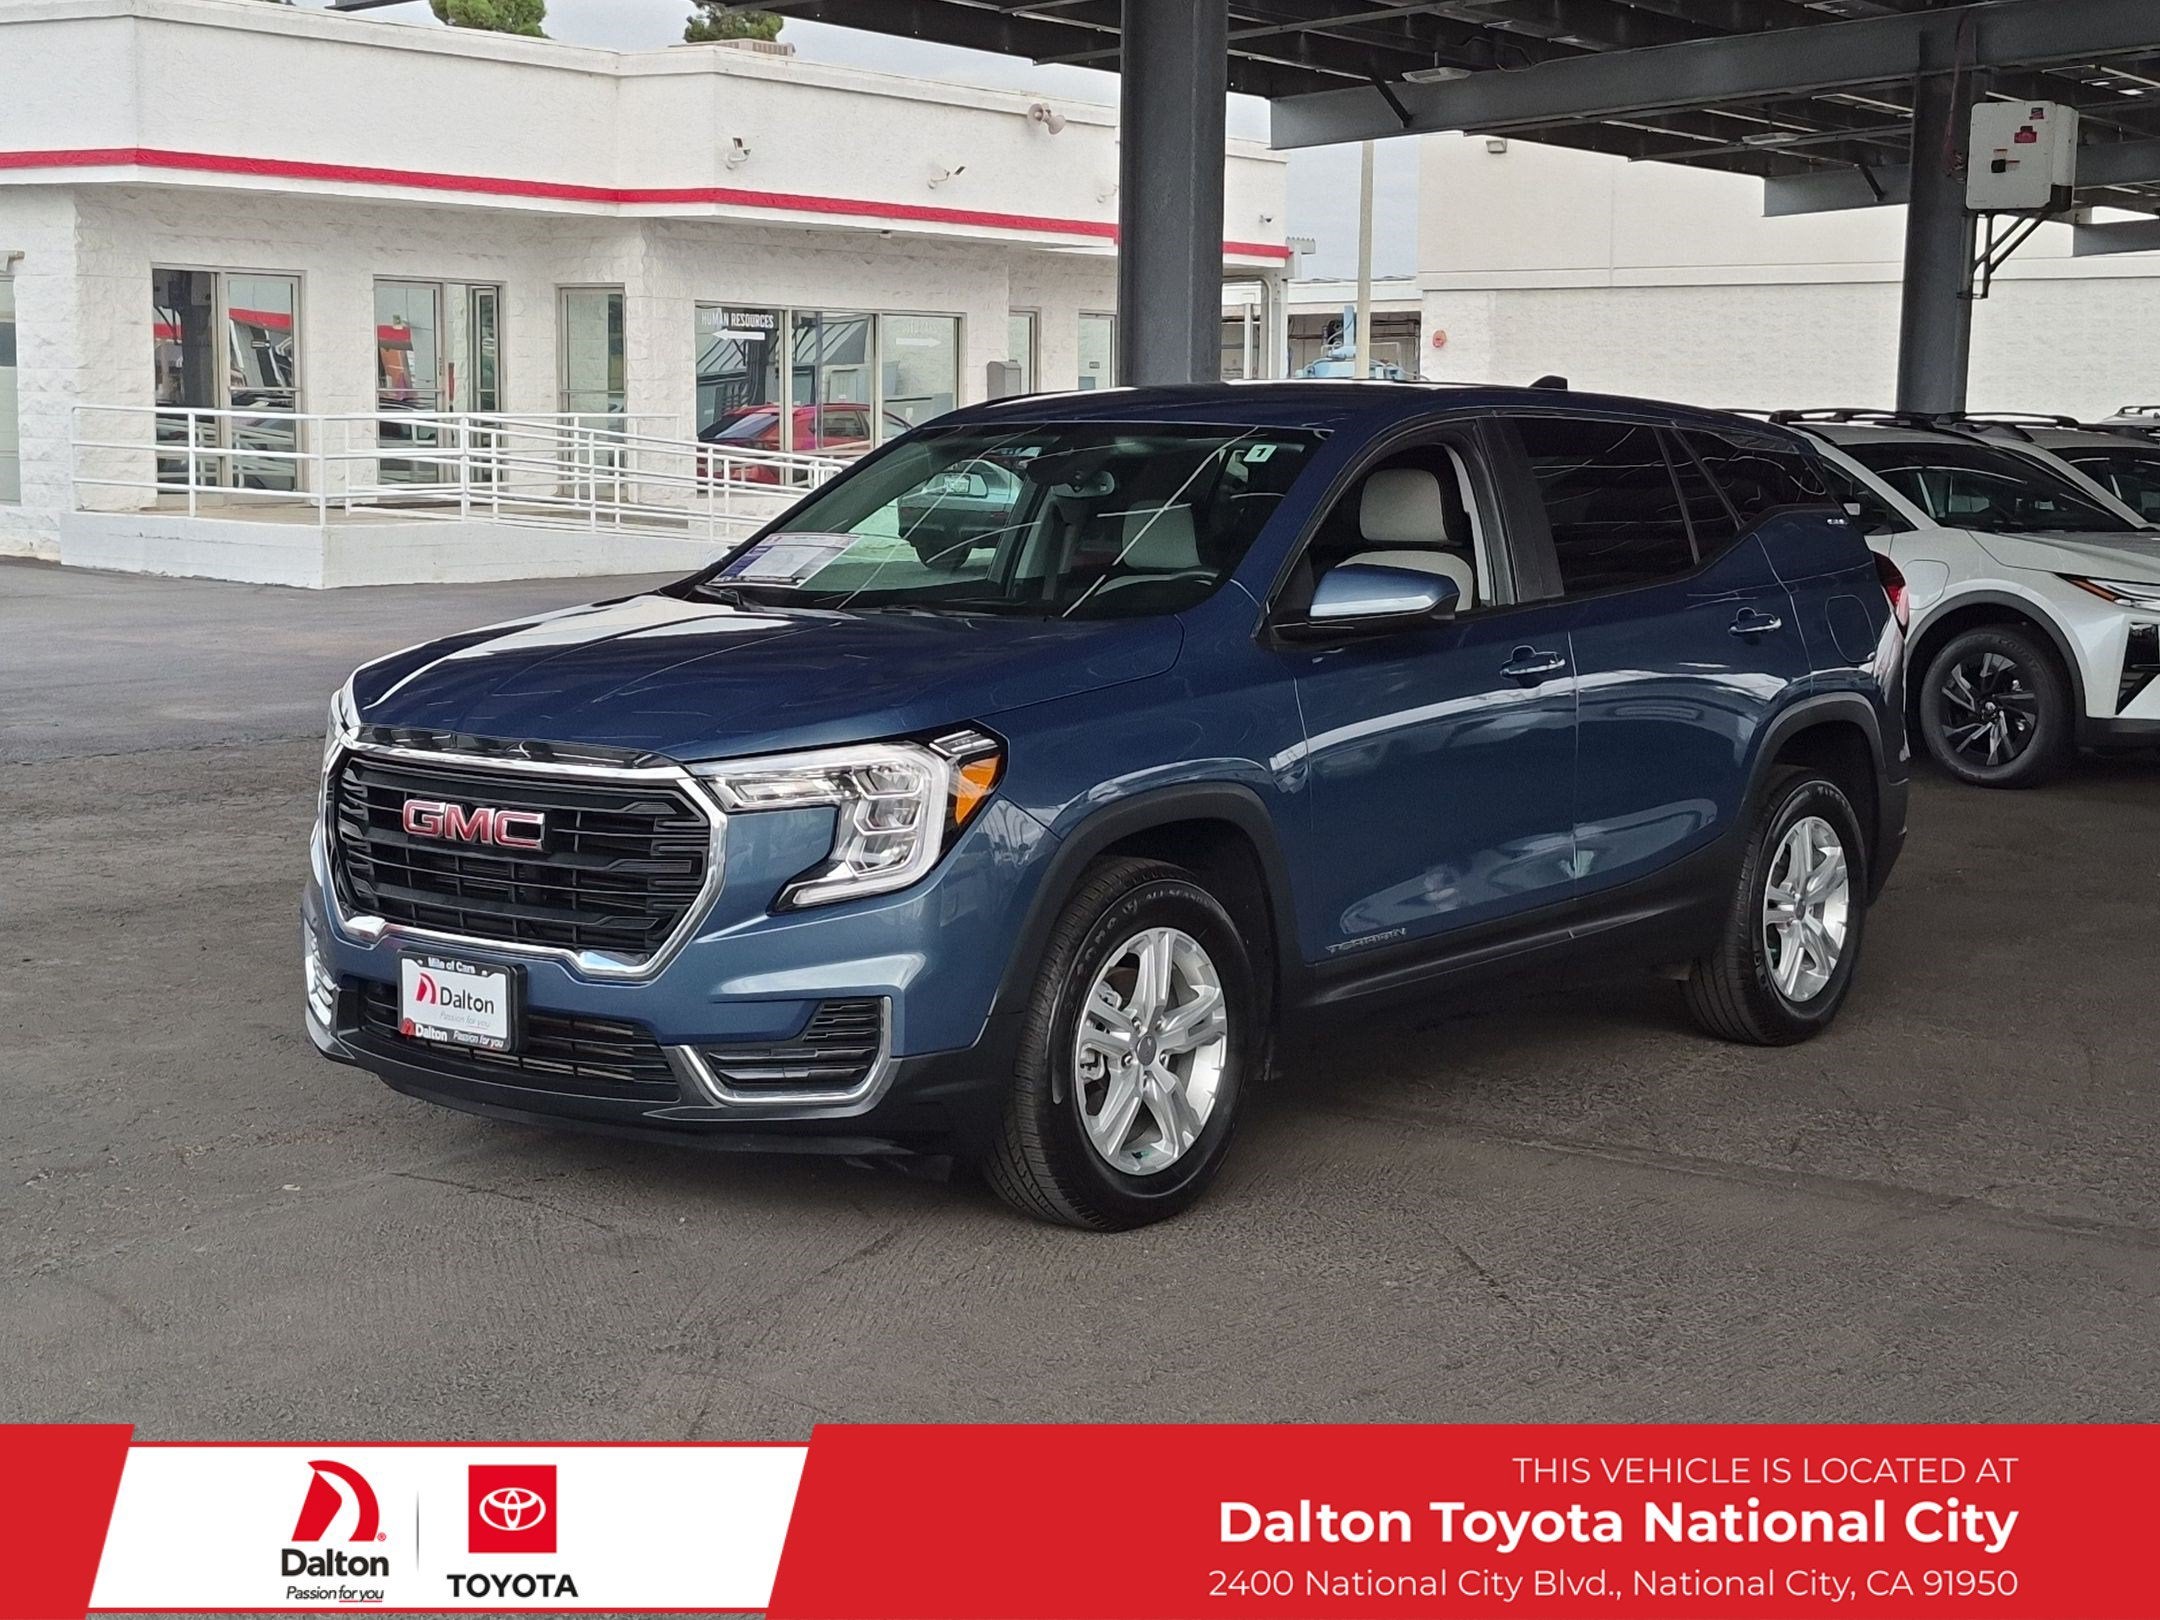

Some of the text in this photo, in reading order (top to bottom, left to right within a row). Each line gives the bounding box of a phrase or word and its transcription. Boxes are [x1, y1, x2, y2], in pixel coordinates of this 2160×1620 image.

[701, 311, 775, 328] HUMAN RESOURCES
[402, 799, 545, 850] GMC
[428, 957, 476, 974] Mile of Cars
[440, 986, 495, 1015] Dalton
[415, 1023, 504, 1049] Dalton Passion for you
